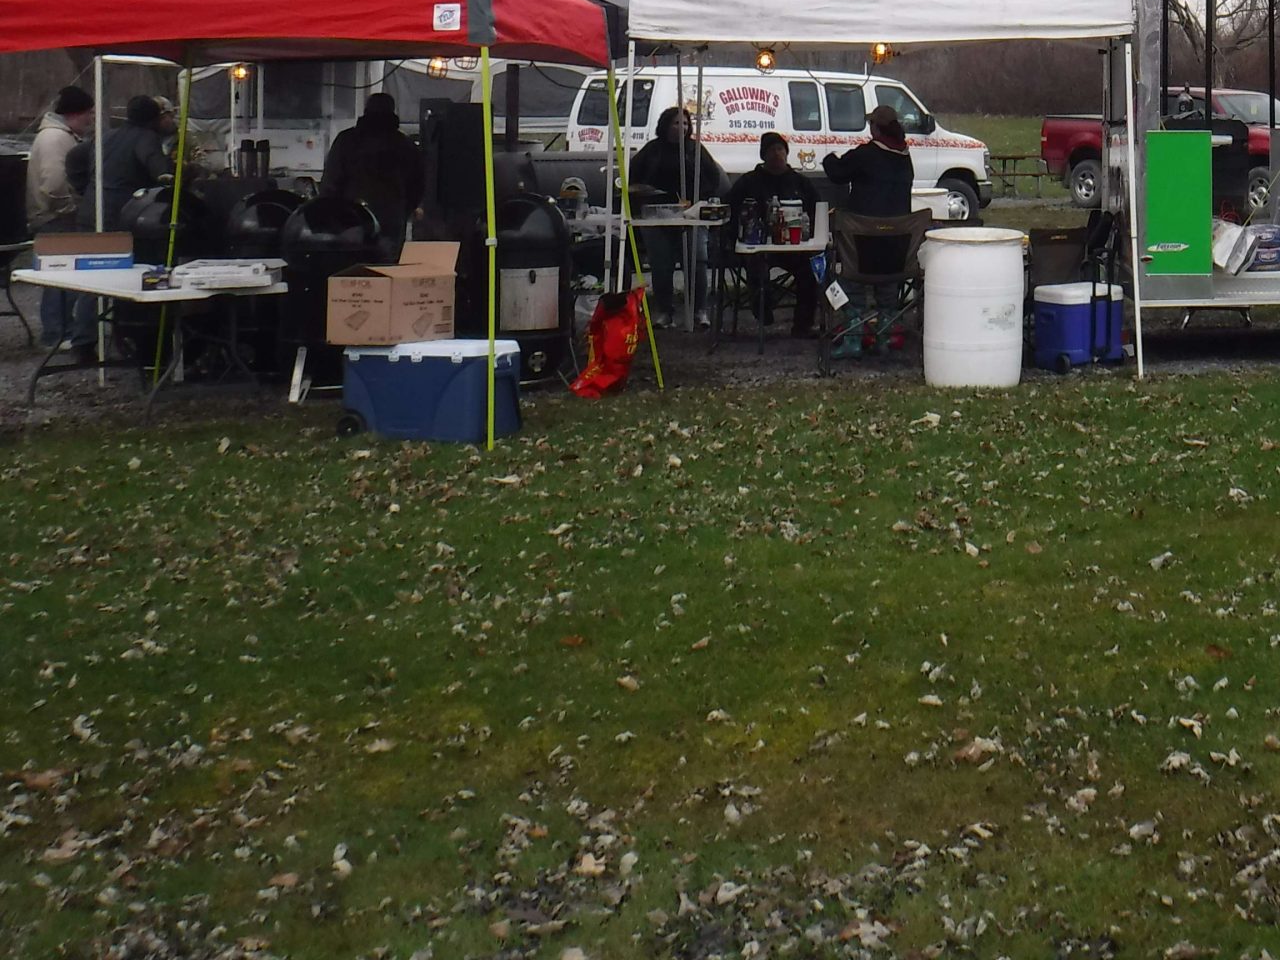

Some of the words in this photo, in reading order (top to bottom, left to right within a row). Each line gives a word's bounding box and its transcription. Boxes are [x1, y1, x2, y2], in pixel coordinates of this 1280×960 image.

[719, 86, 780, 108] GALLOWAY'S
[726, 102, 740, 116] BBQ
[746, 101, 777, 118] CATERING
[729, 120, 742, 129] 315
[743, 120, 775, 129] 263-0116
